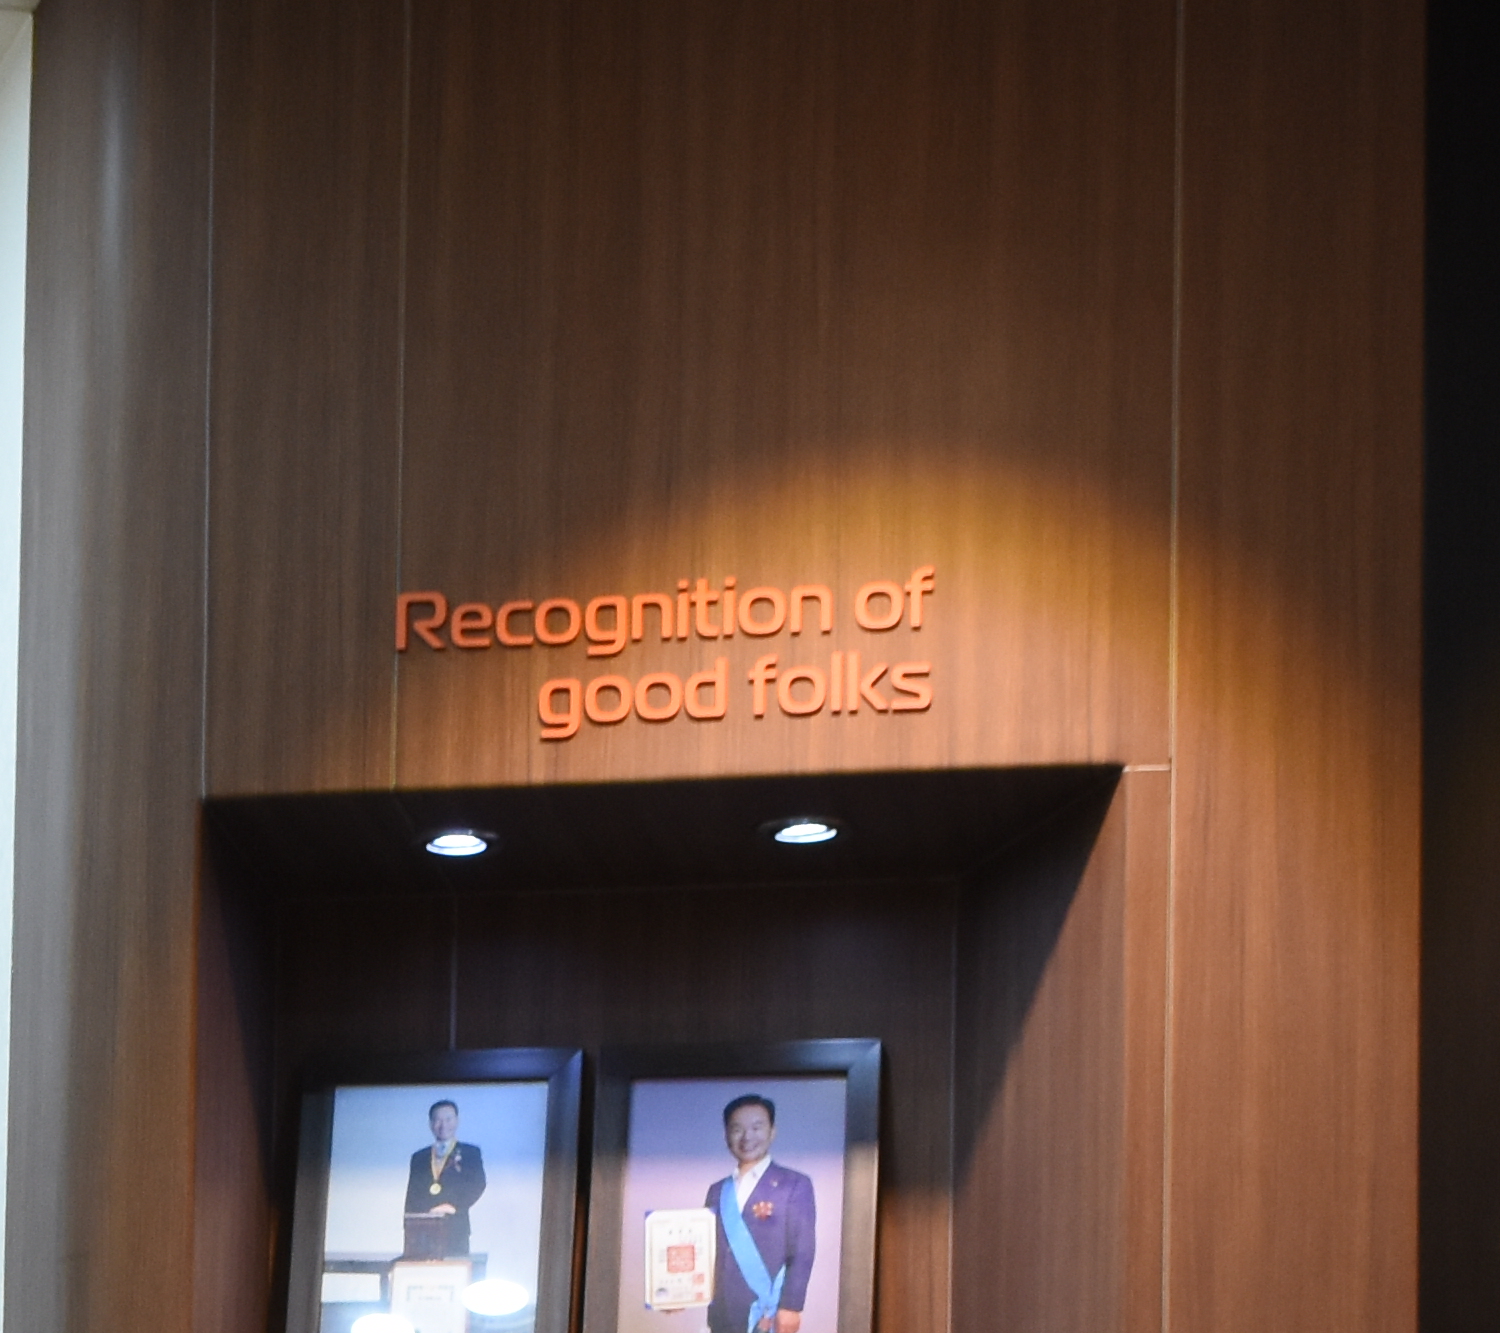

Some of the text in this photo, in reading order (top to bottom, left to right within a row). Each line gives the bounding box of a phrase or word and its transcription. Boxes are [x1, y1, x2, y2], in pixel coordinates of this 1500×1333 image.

[395, 564, 936, 658] Recognition of
[537, 648, 935, 740] good folks
